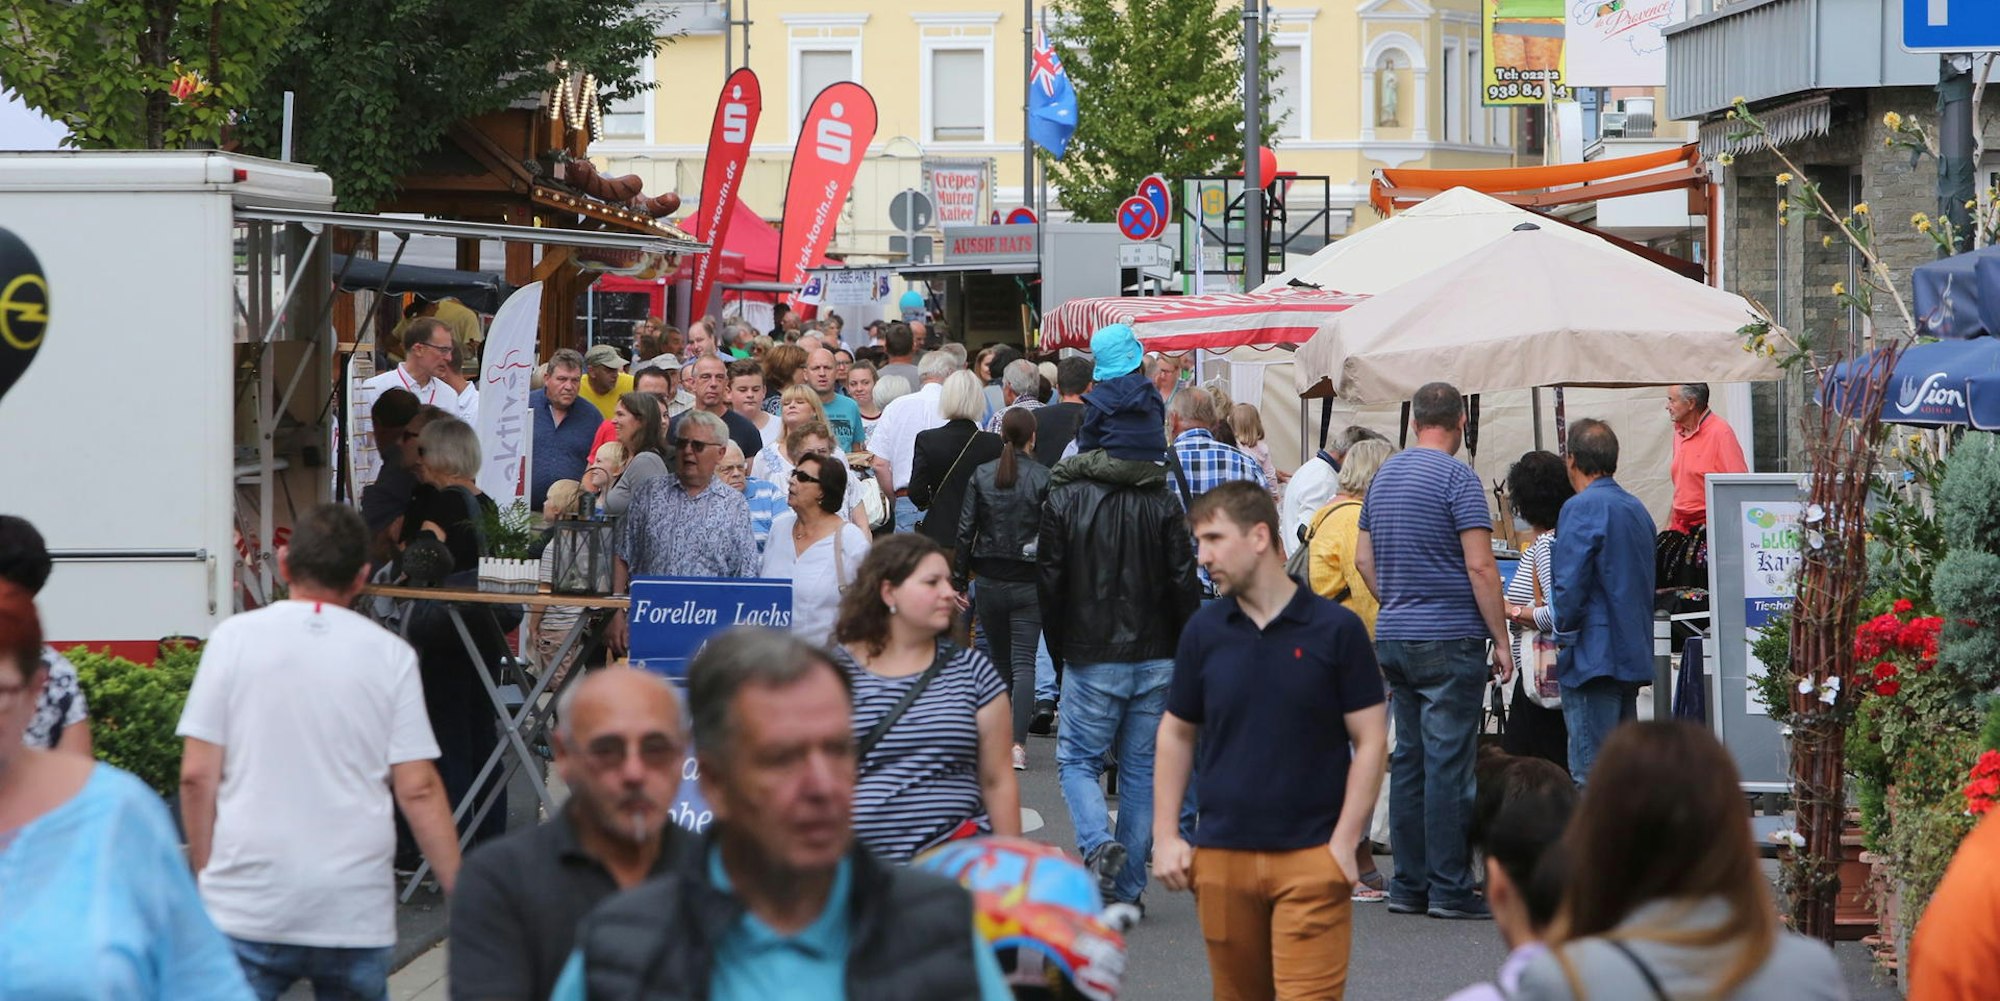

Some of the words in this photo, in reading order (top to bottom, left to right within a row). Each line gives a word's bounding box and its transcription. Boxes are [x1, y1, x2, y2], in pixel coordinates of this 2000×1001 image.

[1496, 68, 1519, 80] Tel:
[1489, 83, 1519, 99] 938
[1521, 82, 1543, 98] 84
[935, 171, 978, 190] Crêpes
[953, 237, 997, 254] AUSSIE
[999, 236, 1033, 252] HATS
[1895, 372, 1966, 415] Sion
[633, 600, 717, 625] Forellen
[732, 602, 791, 627] Lachs
